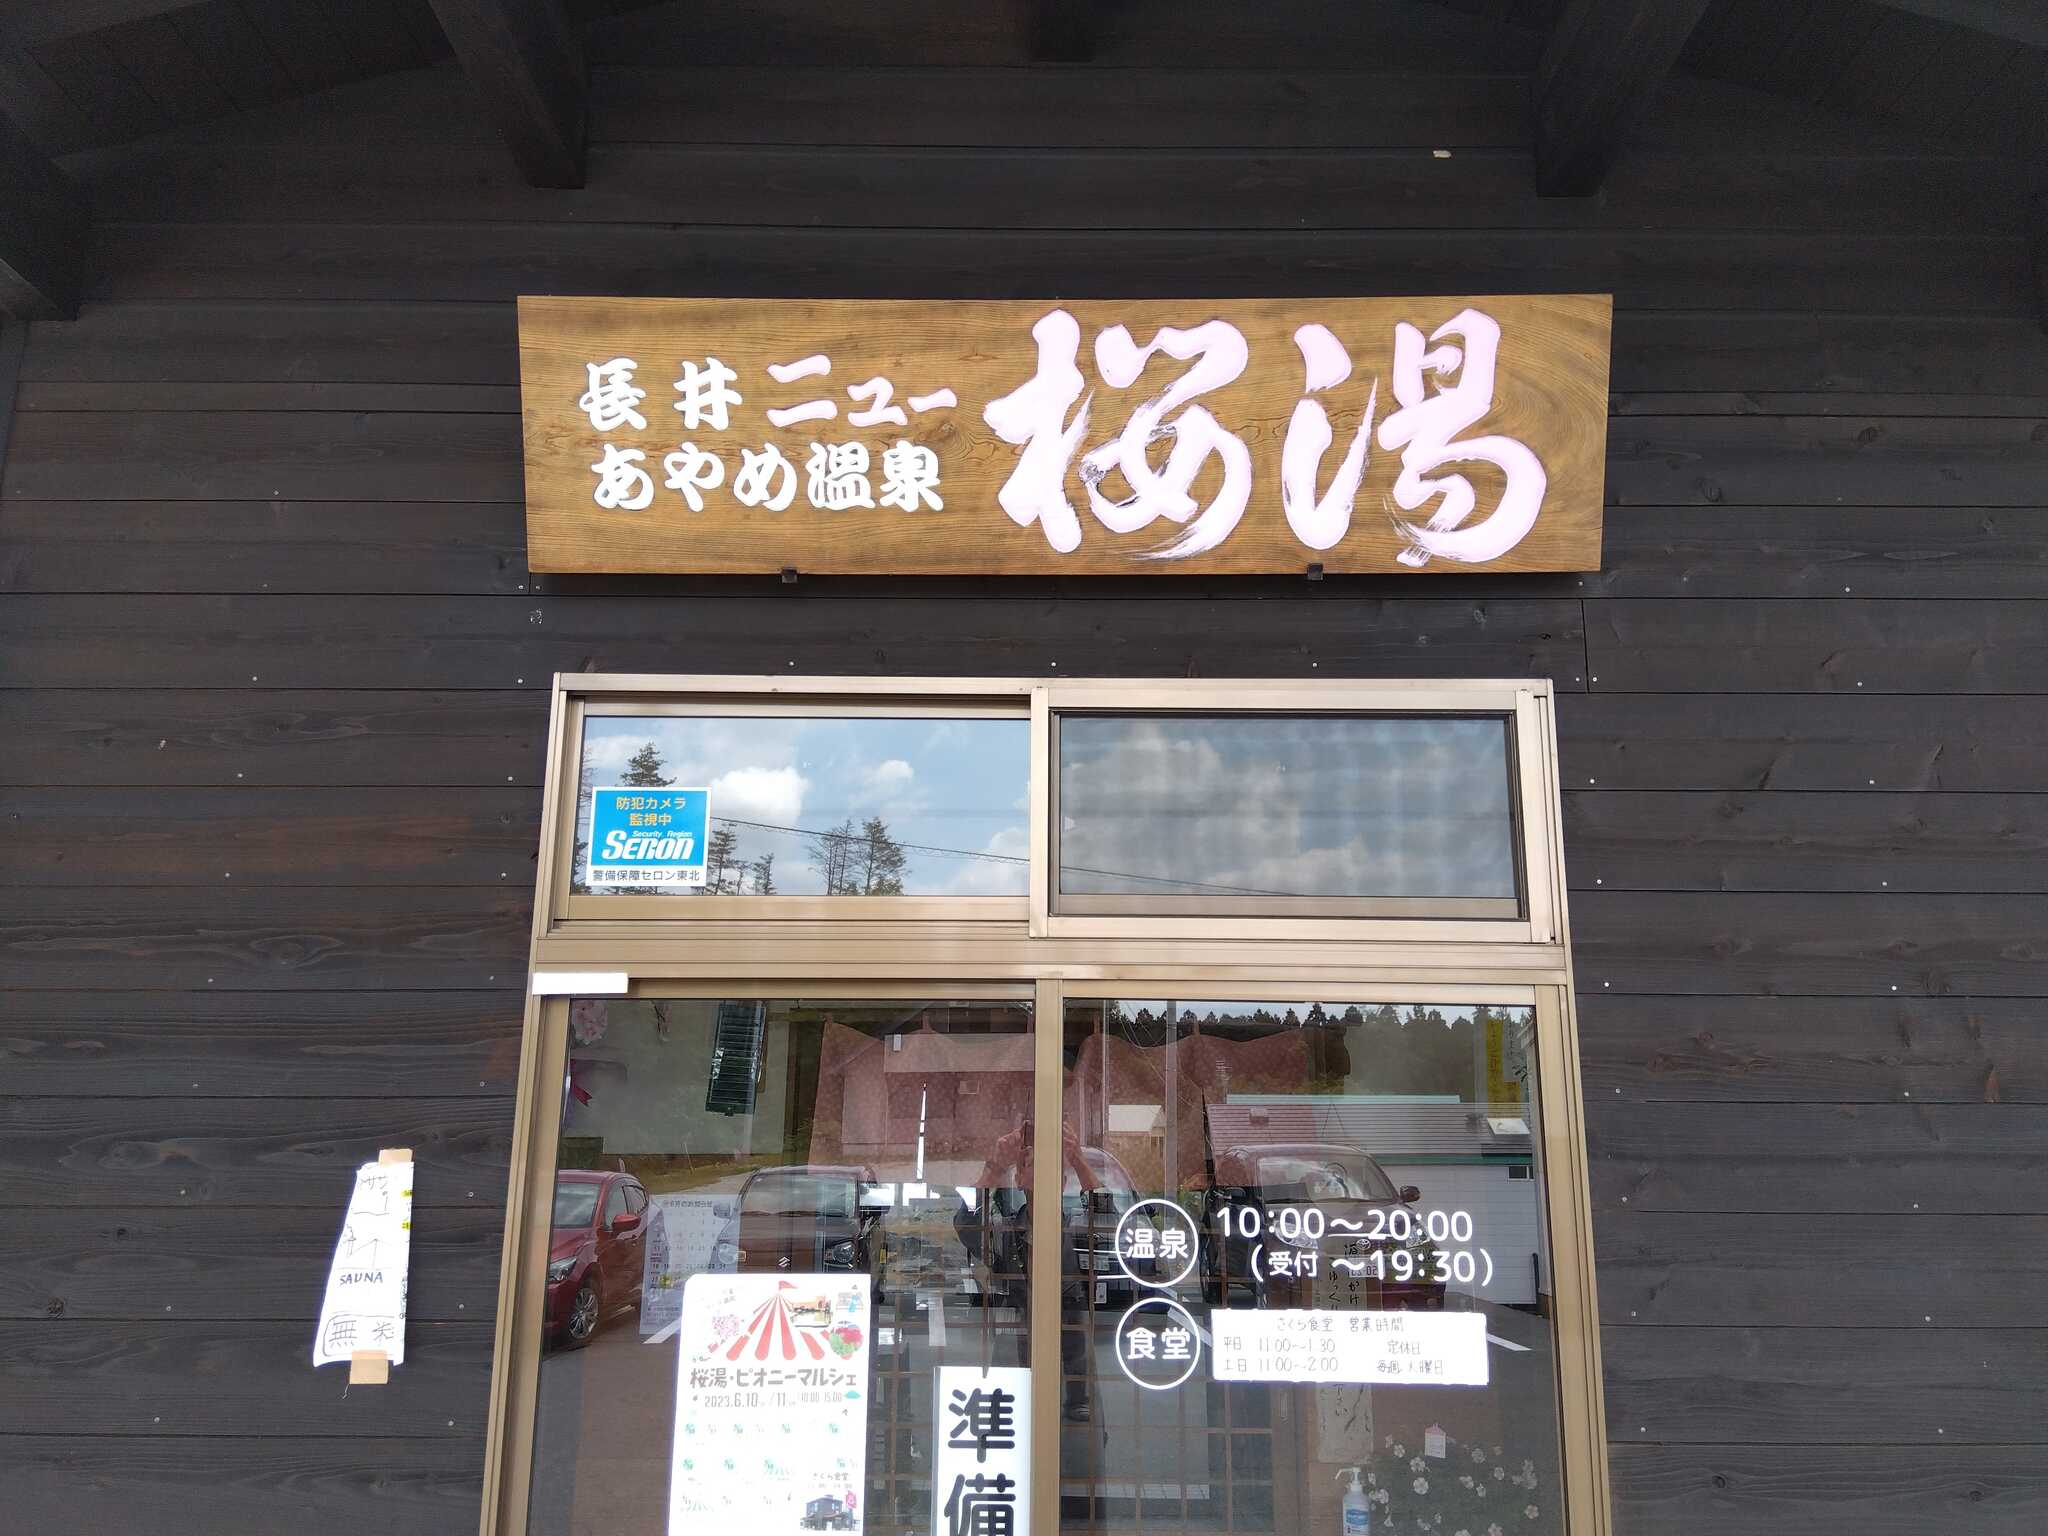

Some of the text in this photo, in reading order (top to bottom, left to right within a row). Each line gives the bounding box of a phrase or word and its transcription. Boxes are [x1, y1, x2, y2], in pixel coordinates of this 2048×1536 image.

[591, 440, 945, 512] あやめ温泉
[616, 796, 687, 811] 防犯カメラ
[629, 812, 672, 826] 監視中
[1216, 1207, 1473, 1242] 10:00〜20:00
[1126, 1228, 1189, 1260] 温泉
[339, 1271, 383, 1286] SAUNA
[1349, 1317, 1405, 1333] 営業時間
[1126, 1327, 1191, 1360] 食堂
[1223, 1336, 1336, 1353] 平日 1100〜130
[1387, 1339, 1422, 1355] 定休日
[1258, 1357, 1339, 1373] 1100〜200
[690, 1367, 857, 1389] 桜湯・ピオニーマルシェ
[944, 1387, 1016, 1536] 準備
